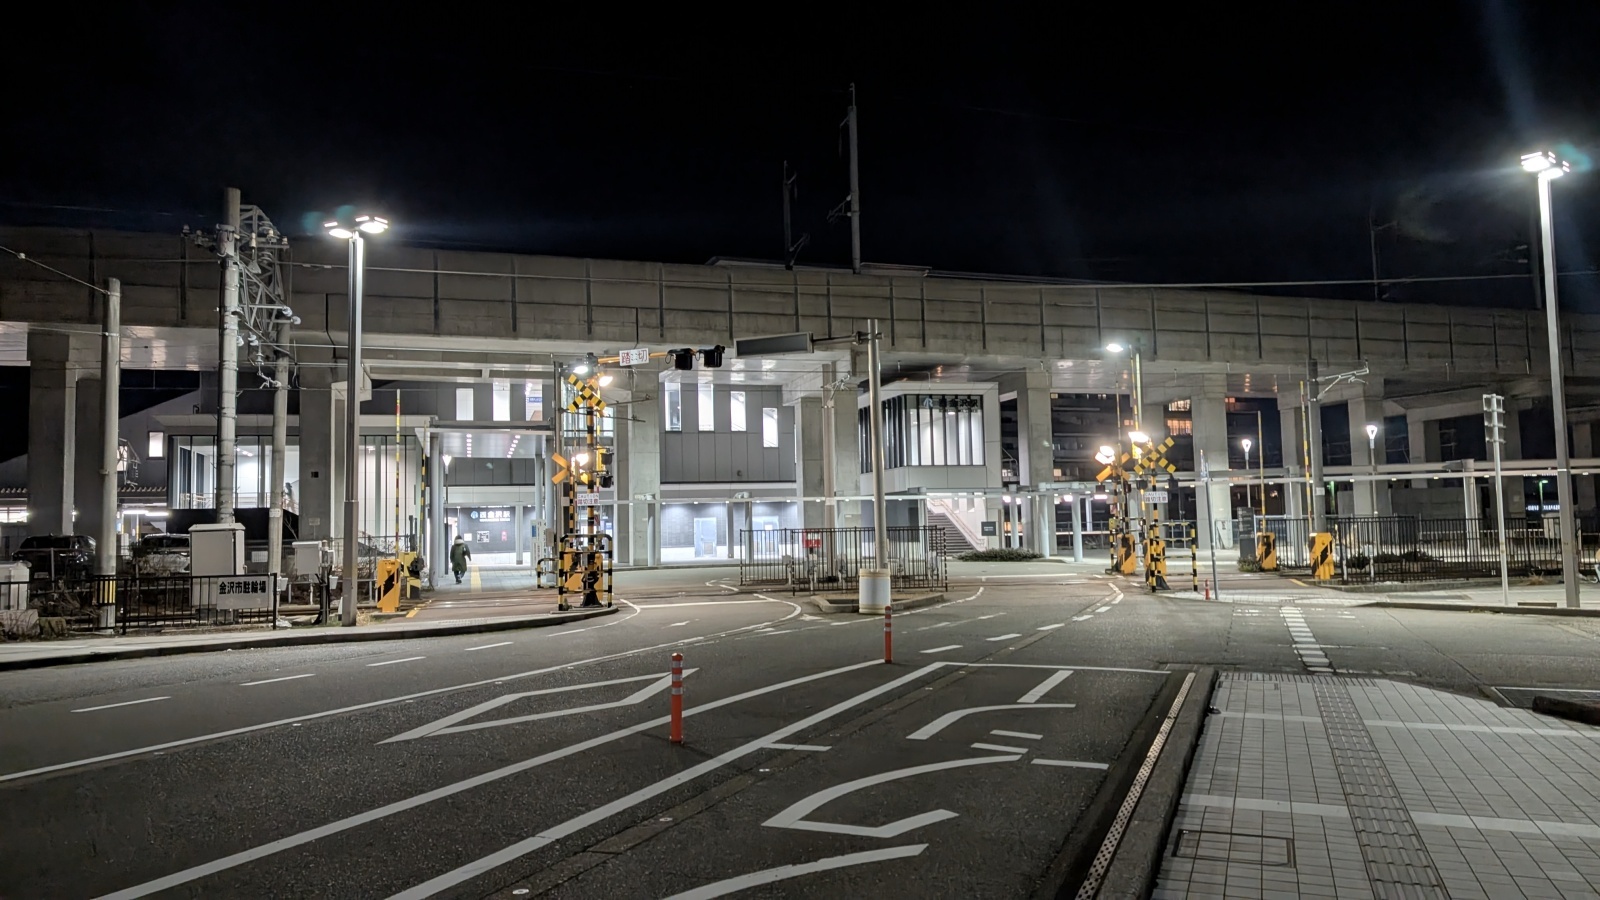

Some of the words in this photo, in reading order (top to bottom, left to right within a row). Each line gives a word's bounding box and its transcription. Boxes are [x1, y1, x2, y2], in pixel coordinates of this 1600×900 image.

[621, 350, 648, 364] 踏切
[219, 580, 266, 594] 金沢市駐輪場
